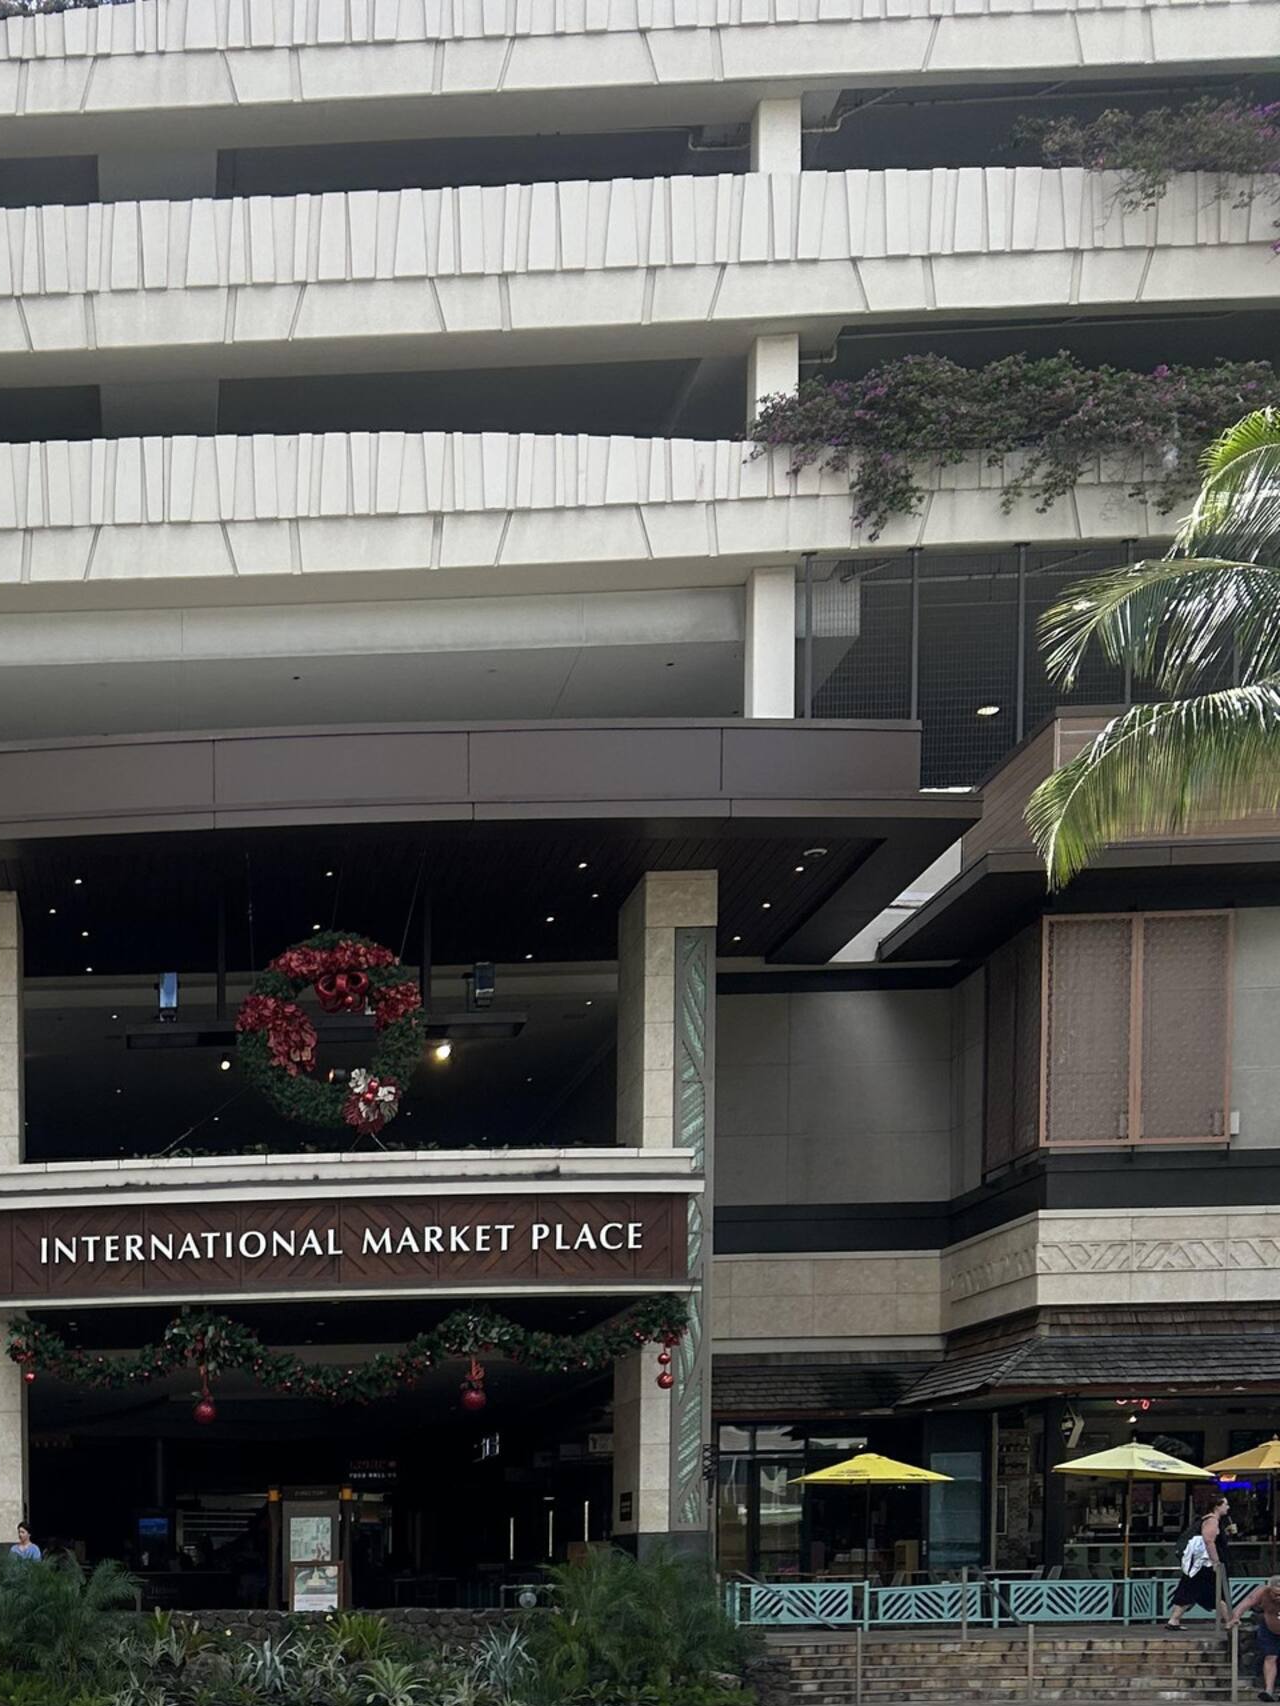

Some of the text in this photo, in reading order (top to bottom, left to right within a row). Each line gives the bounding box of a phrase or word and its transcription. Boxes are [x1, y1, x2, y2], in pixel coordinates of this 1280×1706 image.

[40, 1222, 644, 1264] INTERNATIONAL MARKET PLACE
